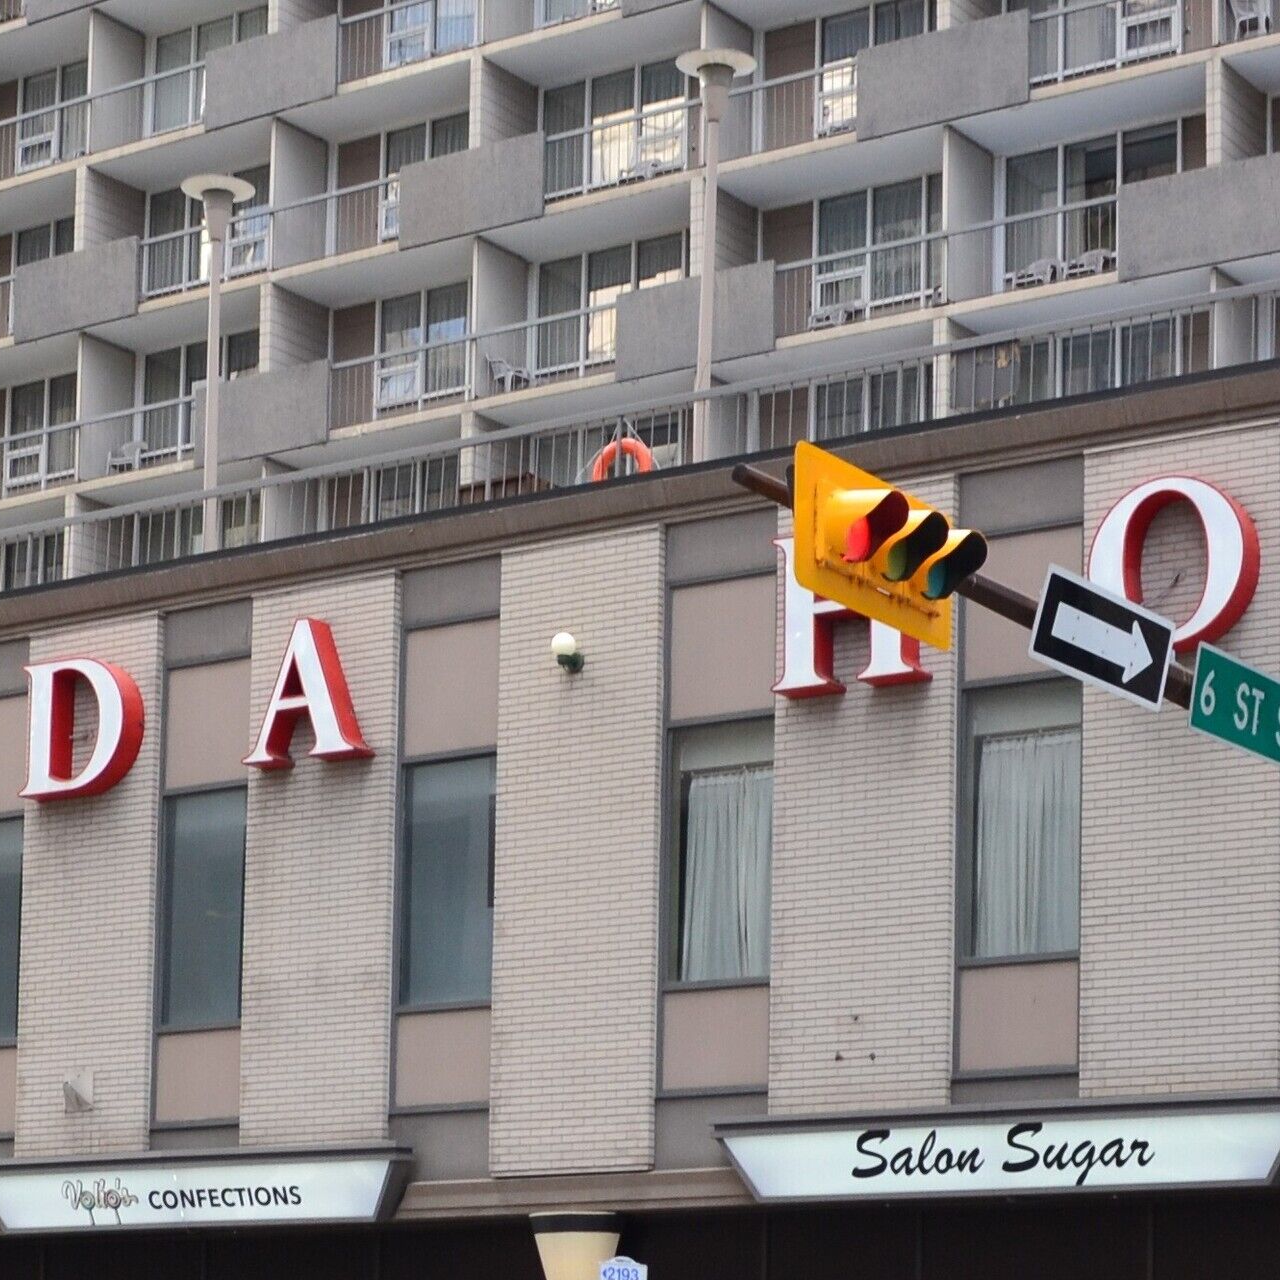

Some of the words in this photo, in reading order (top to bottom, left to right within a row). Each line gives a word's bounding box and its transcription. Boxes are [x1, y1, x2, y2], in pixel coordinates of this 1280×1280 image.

[1200, 669, 1216, 716] 6
[1233, 682, 1265, 736] ST
[851, 1128, 985, 1179] Salon
[1001, 1121, 1156, 1187] Sugar
[148, 1185, 303, 1210] CONFECTIONS
